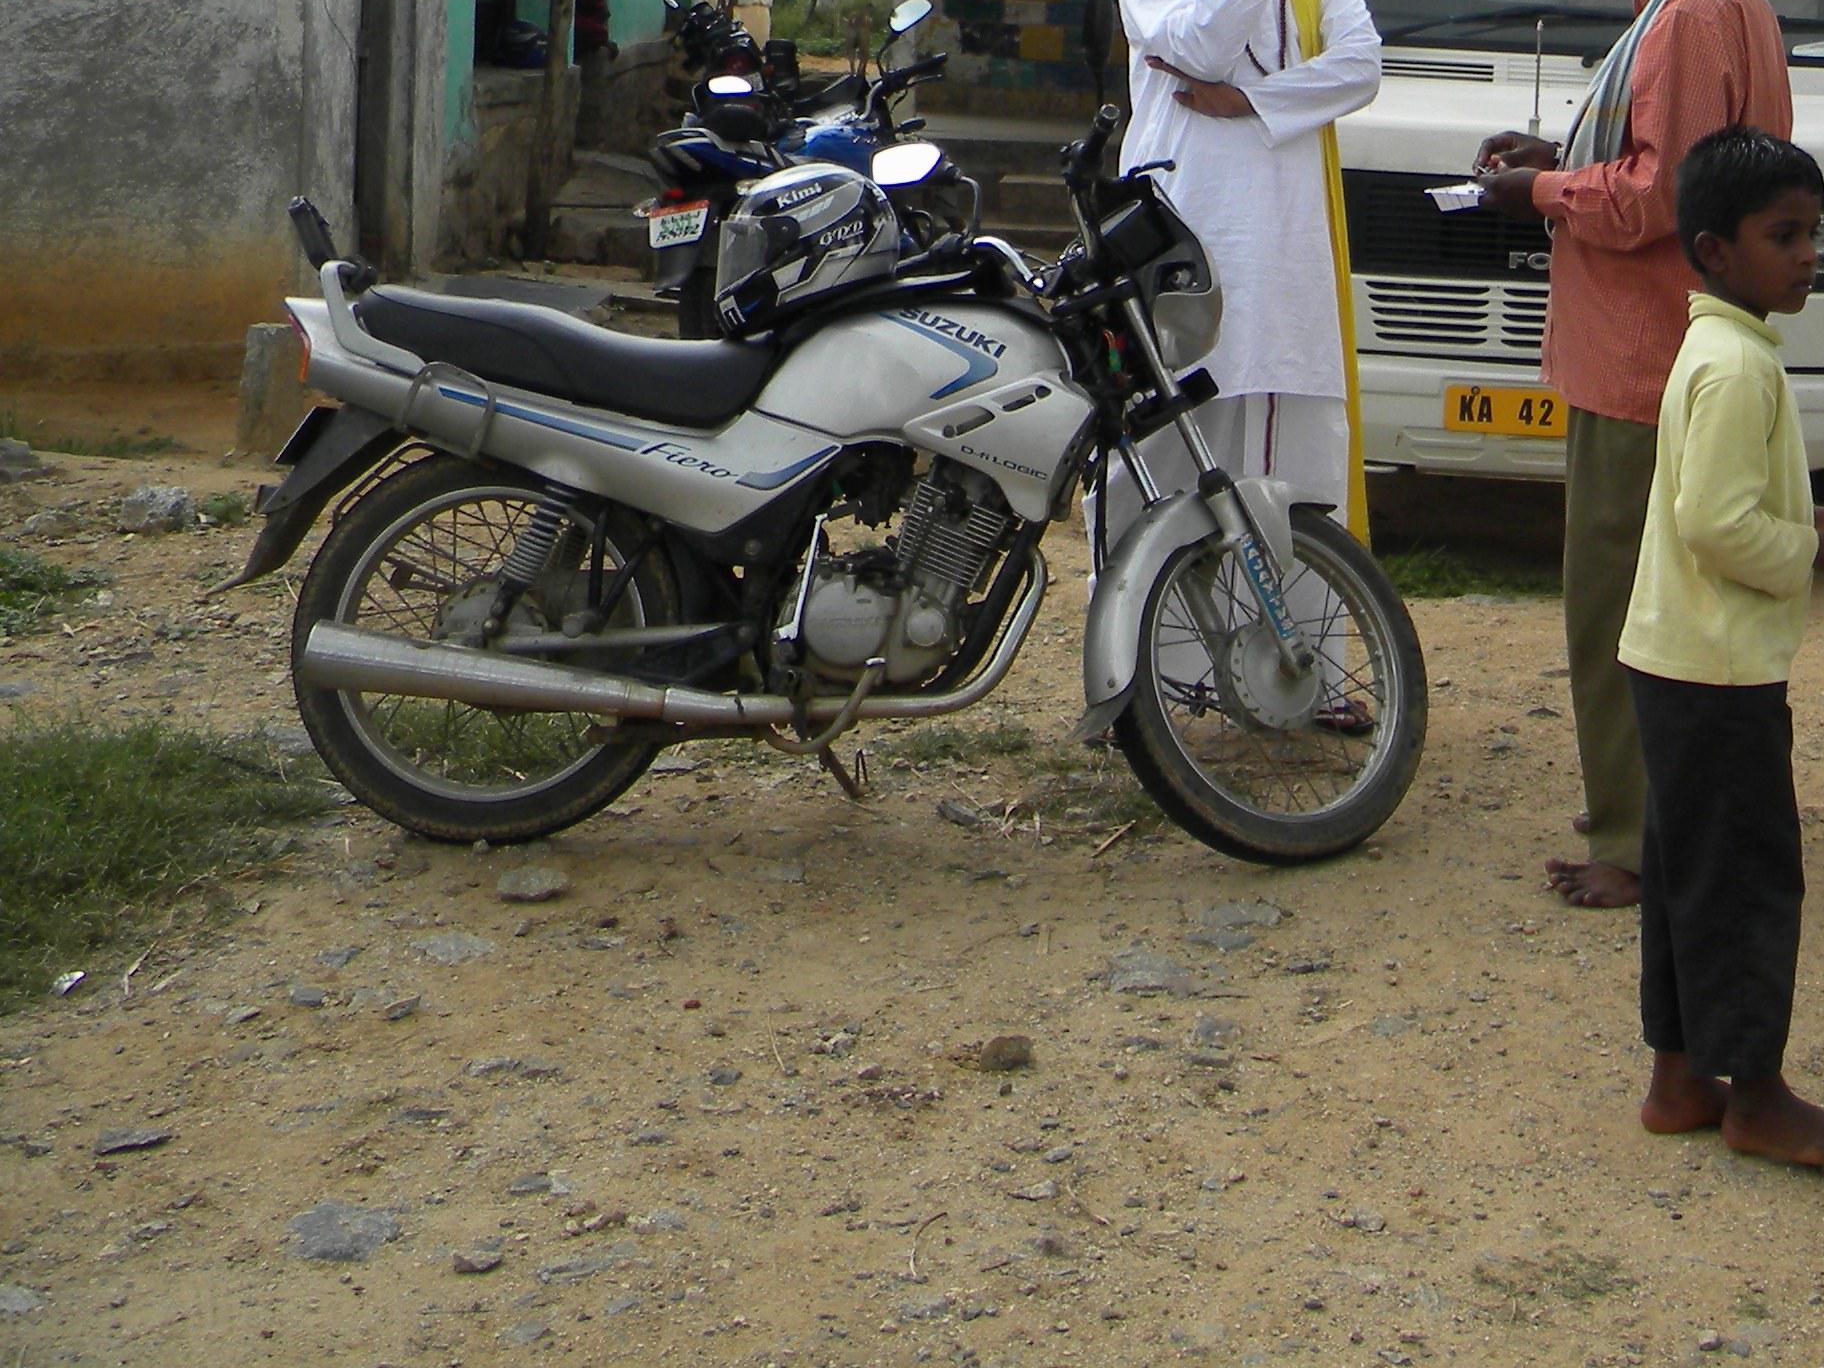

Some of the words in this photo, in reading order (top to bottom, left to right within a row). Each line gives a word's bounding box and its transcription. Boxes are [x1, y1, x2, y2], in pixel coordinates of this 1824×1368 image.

[1508, 251, 1551, 272] FO
[899, 308, 1008, 360] SUZUKI
[1458, 394, 1493, 424] KA
[1518, 398, 1554, 427] 42
[640, 441, 740, 479] Fiero
[992, 455, 1049, 482] LOGIC
